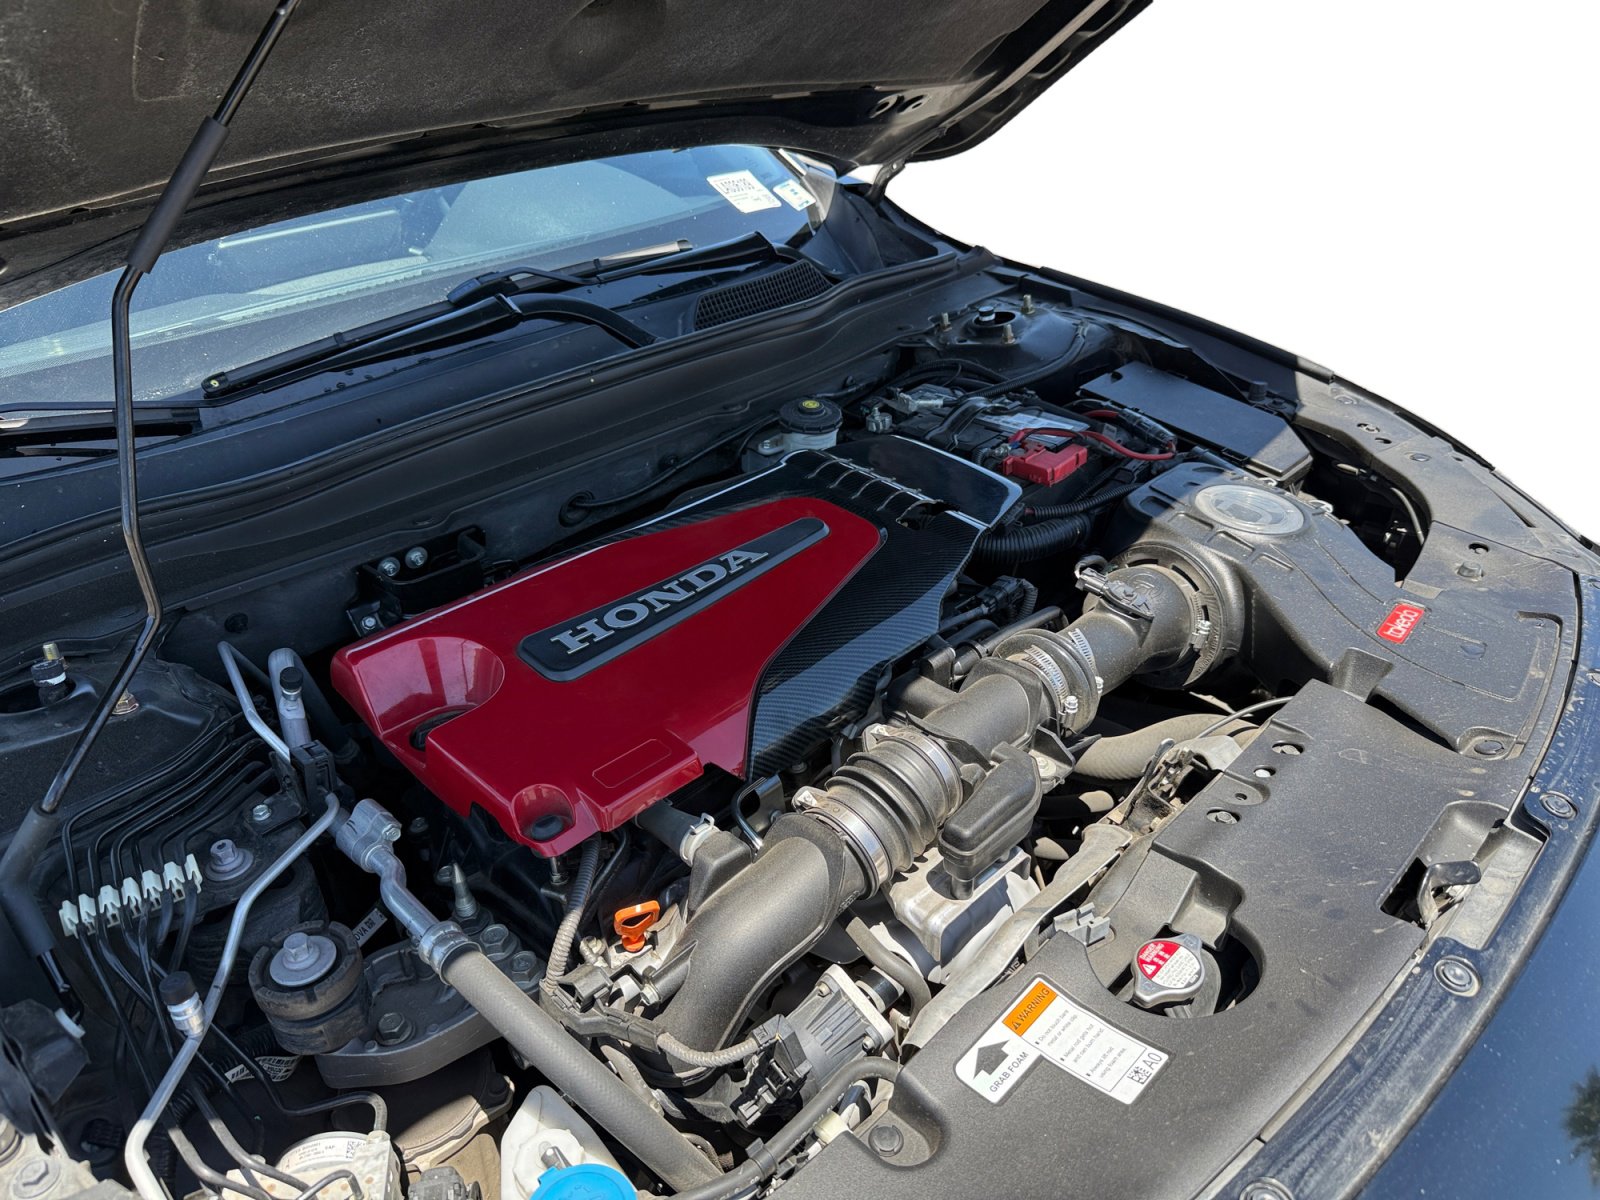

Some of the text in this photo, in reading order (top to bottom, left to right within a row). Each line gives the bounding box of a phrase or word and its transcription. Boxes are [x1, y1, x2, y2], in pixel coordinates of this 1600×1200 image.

[550, 549, 768, 654] HONDA
[1017, 987, 1050, 1022] WARNING
[989, 1051, 1030, 1093] GRAB FOAM
